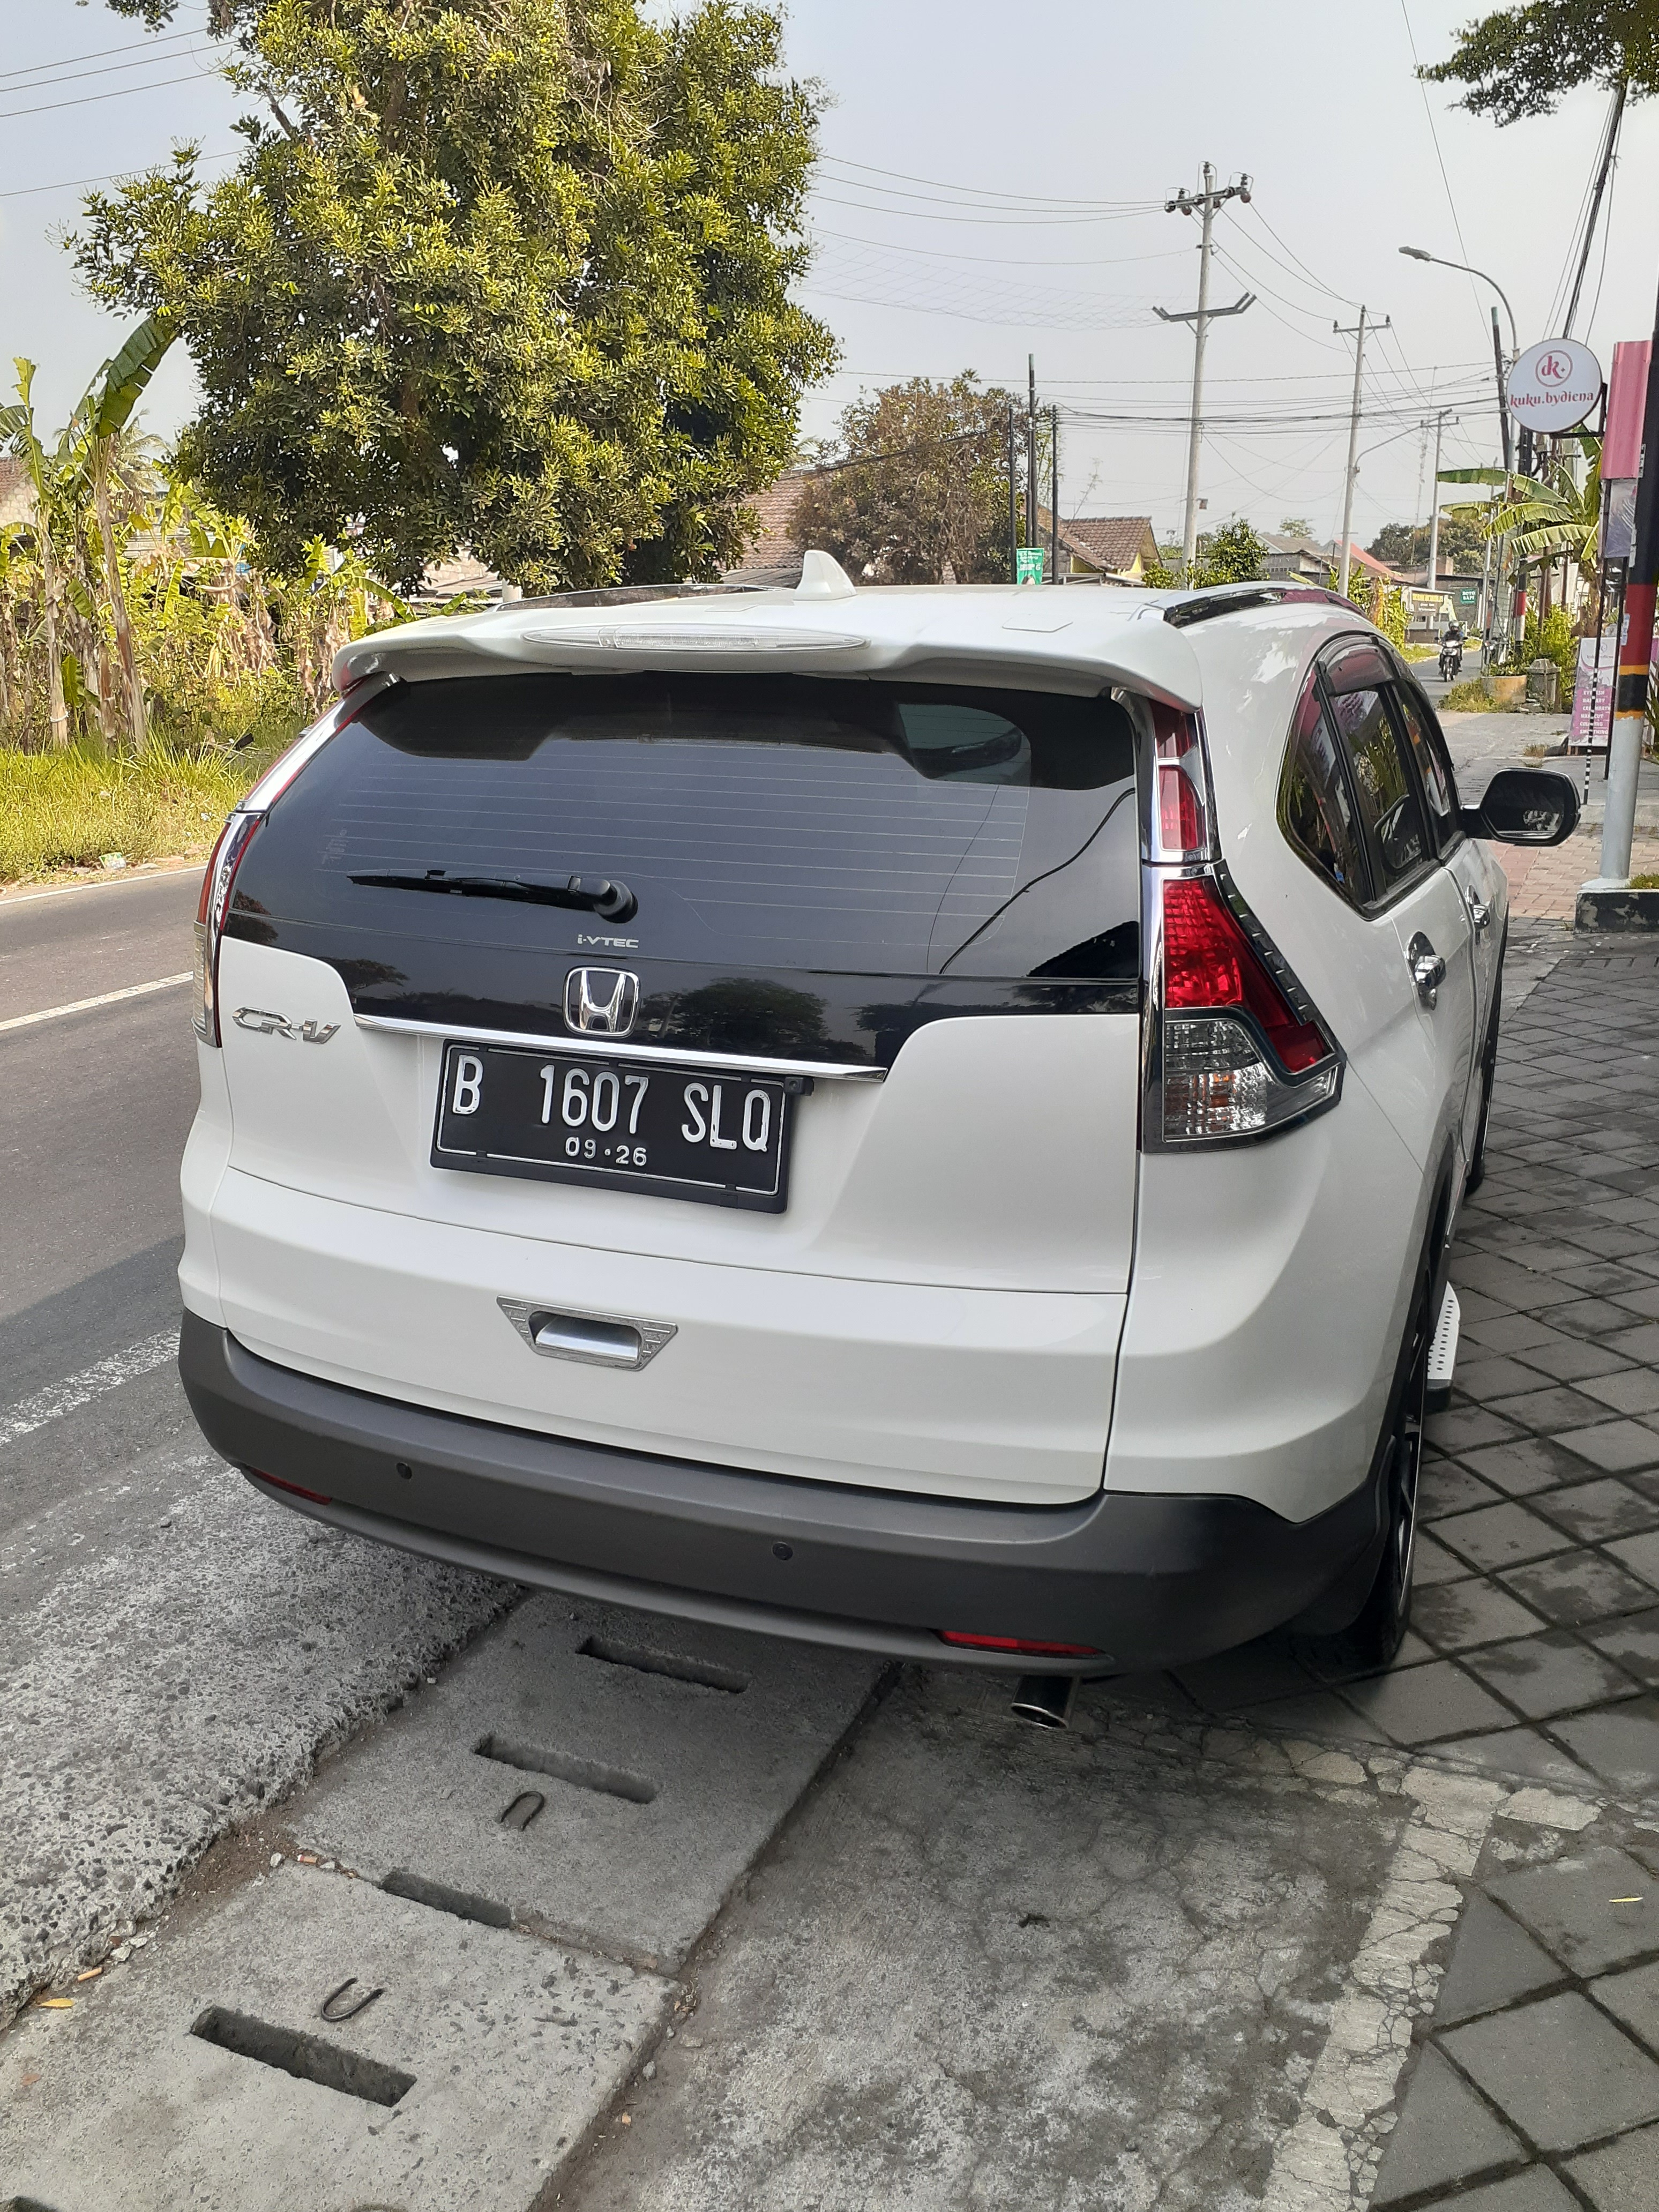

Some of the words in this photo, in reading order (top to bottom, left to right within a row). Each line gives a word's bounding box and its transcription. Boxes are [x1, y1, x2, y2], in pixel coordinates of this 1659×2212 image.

[232, 1006, 342, 1045] CR-V
[452, 1054, 483, 1115] B
[540, 1064, 649, 1134] 1607
[681, 1082, 771, 1152] SLQ
